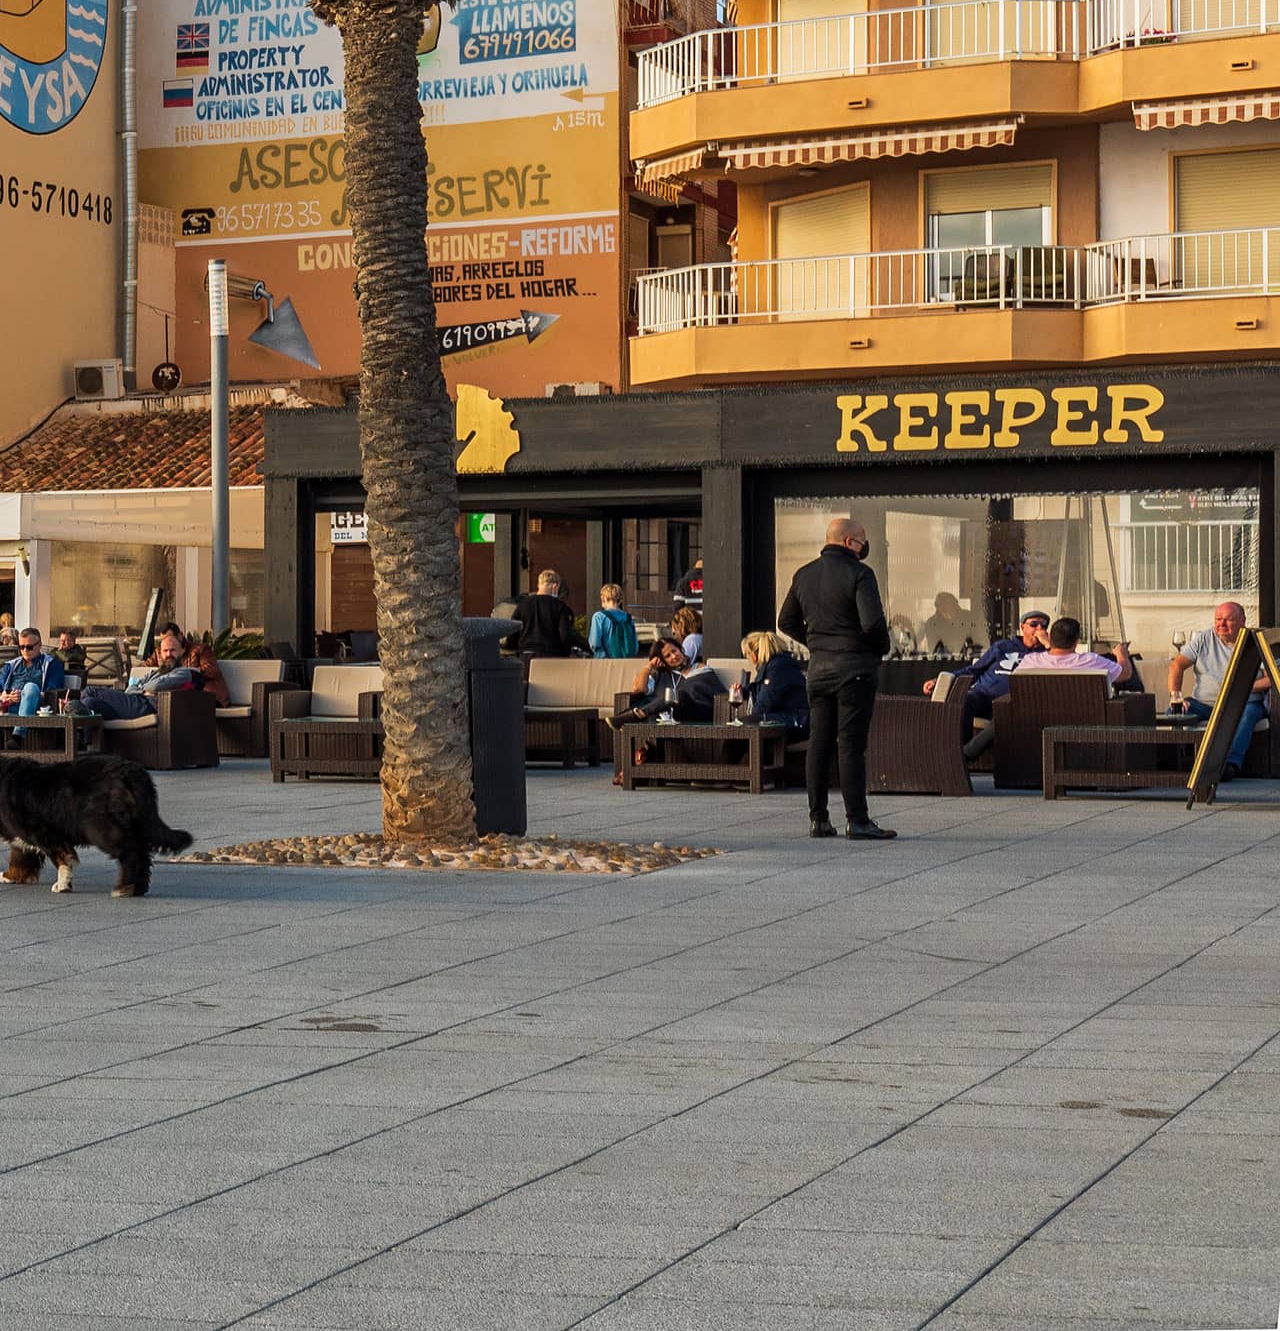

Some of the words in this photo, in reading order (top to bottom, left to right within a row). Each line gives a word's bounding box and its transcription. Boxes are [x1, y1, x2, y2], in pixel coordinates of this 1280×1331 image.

[218, 18, 239, 45] DE
[471, 0, 574, 35] LLAMENOS
[218, 45, 306, 72] PROPERTY
[265, 96, 285, 117] EN
[291, 92, 308, 114] EL
[497, 73, 508, 95] Y
[486, 281, 516, 301] DEL
[836, 383, 1165, 453] KEEPER
